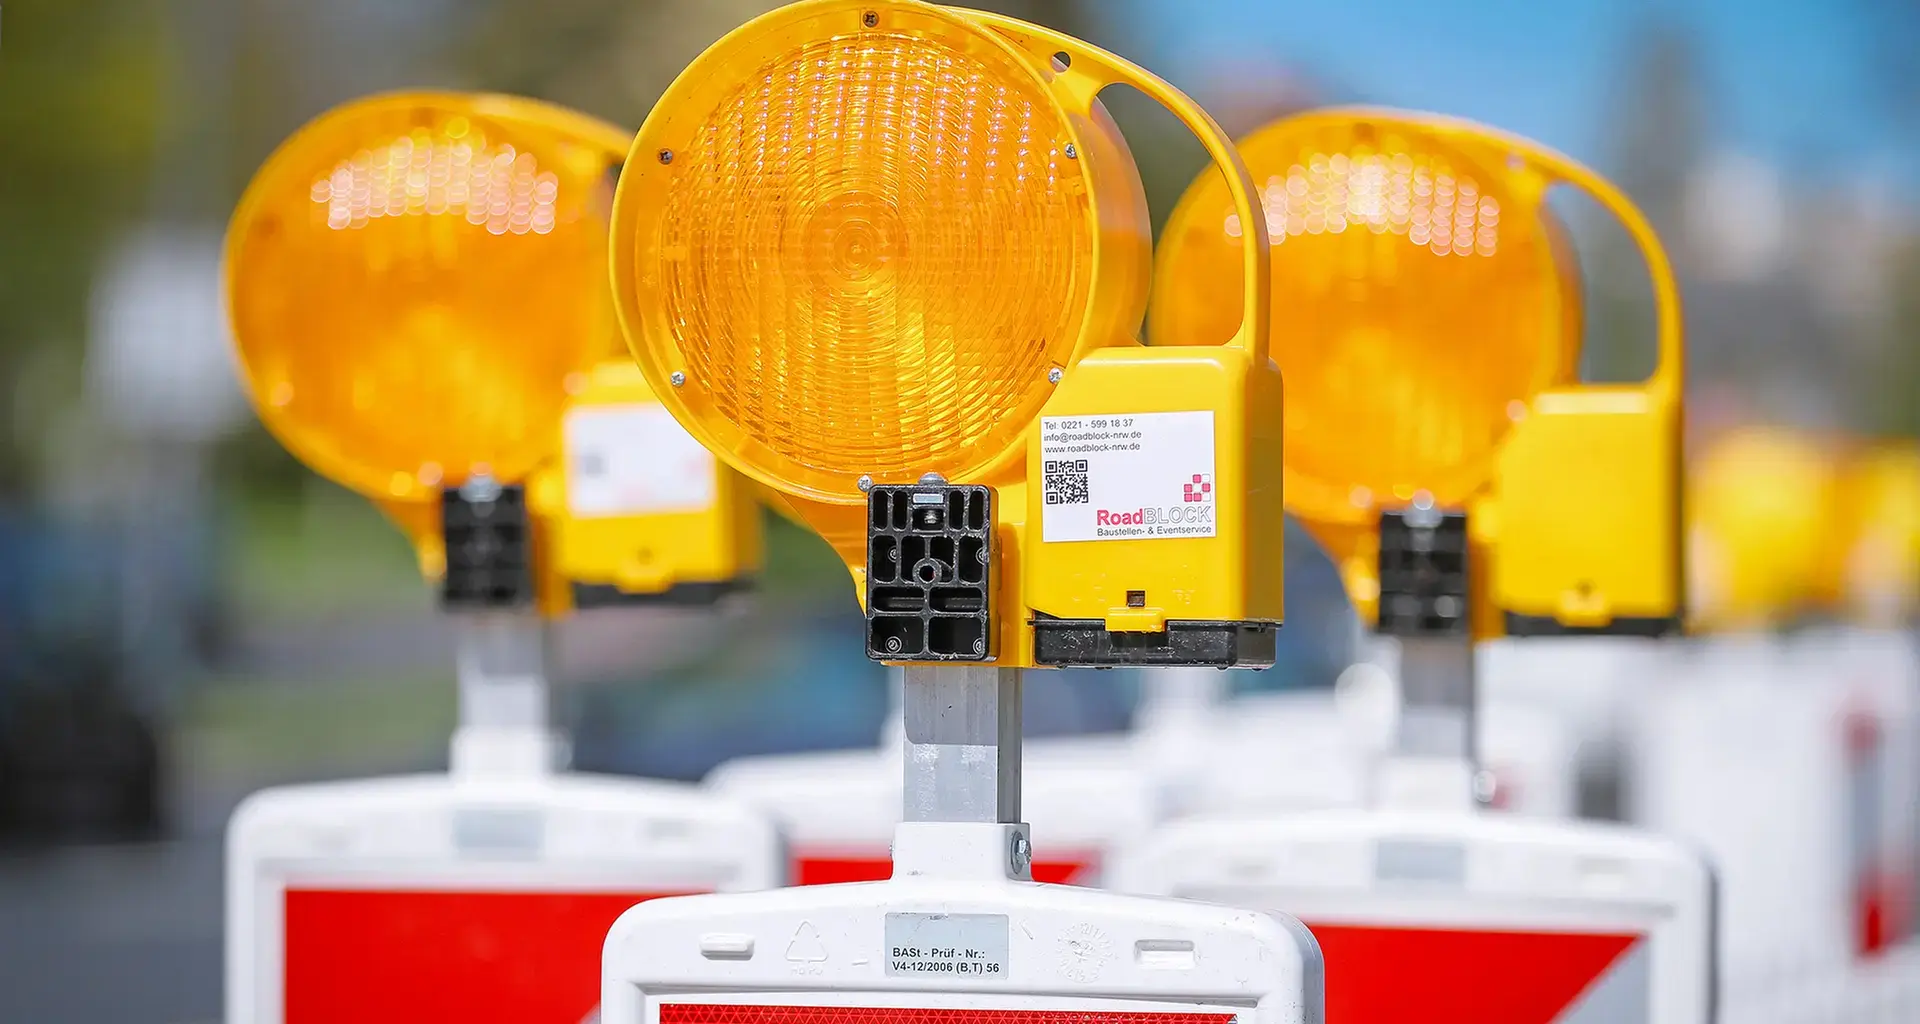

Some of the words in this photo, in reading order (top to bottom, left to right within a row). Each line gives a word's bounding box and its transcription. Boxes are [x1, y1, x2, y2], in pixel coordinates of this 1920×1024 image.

[1061, 421, 1082, 430] 0221
[1091, 420, 1107, 428] 599
[1110, 419, 1121, 428] 18
[1123, 419, 1134, 427] 37
[1044, 431, 1142, 443] info@roadblock-nrw.de
[1044, 442, 1141, 453] www.roadblock-nrw.de
[1096, 506, 1212, 526] RoadBLOCK
[1097, 527, 1146, 537] Baustellen-
[1147, 526, 1154, 535] &
[1157, 525, 1212, 535] Eventservice
[892, 947, 921, 958] BASt
[931, 948, 956, 959] Prüf
[965, 949, 985, 959] Nr.:
[892, 961, 953, 972] V4-12/2006
[956, 962, 983, 975] (B,T)
[986, 963, 1000, 973] 56
